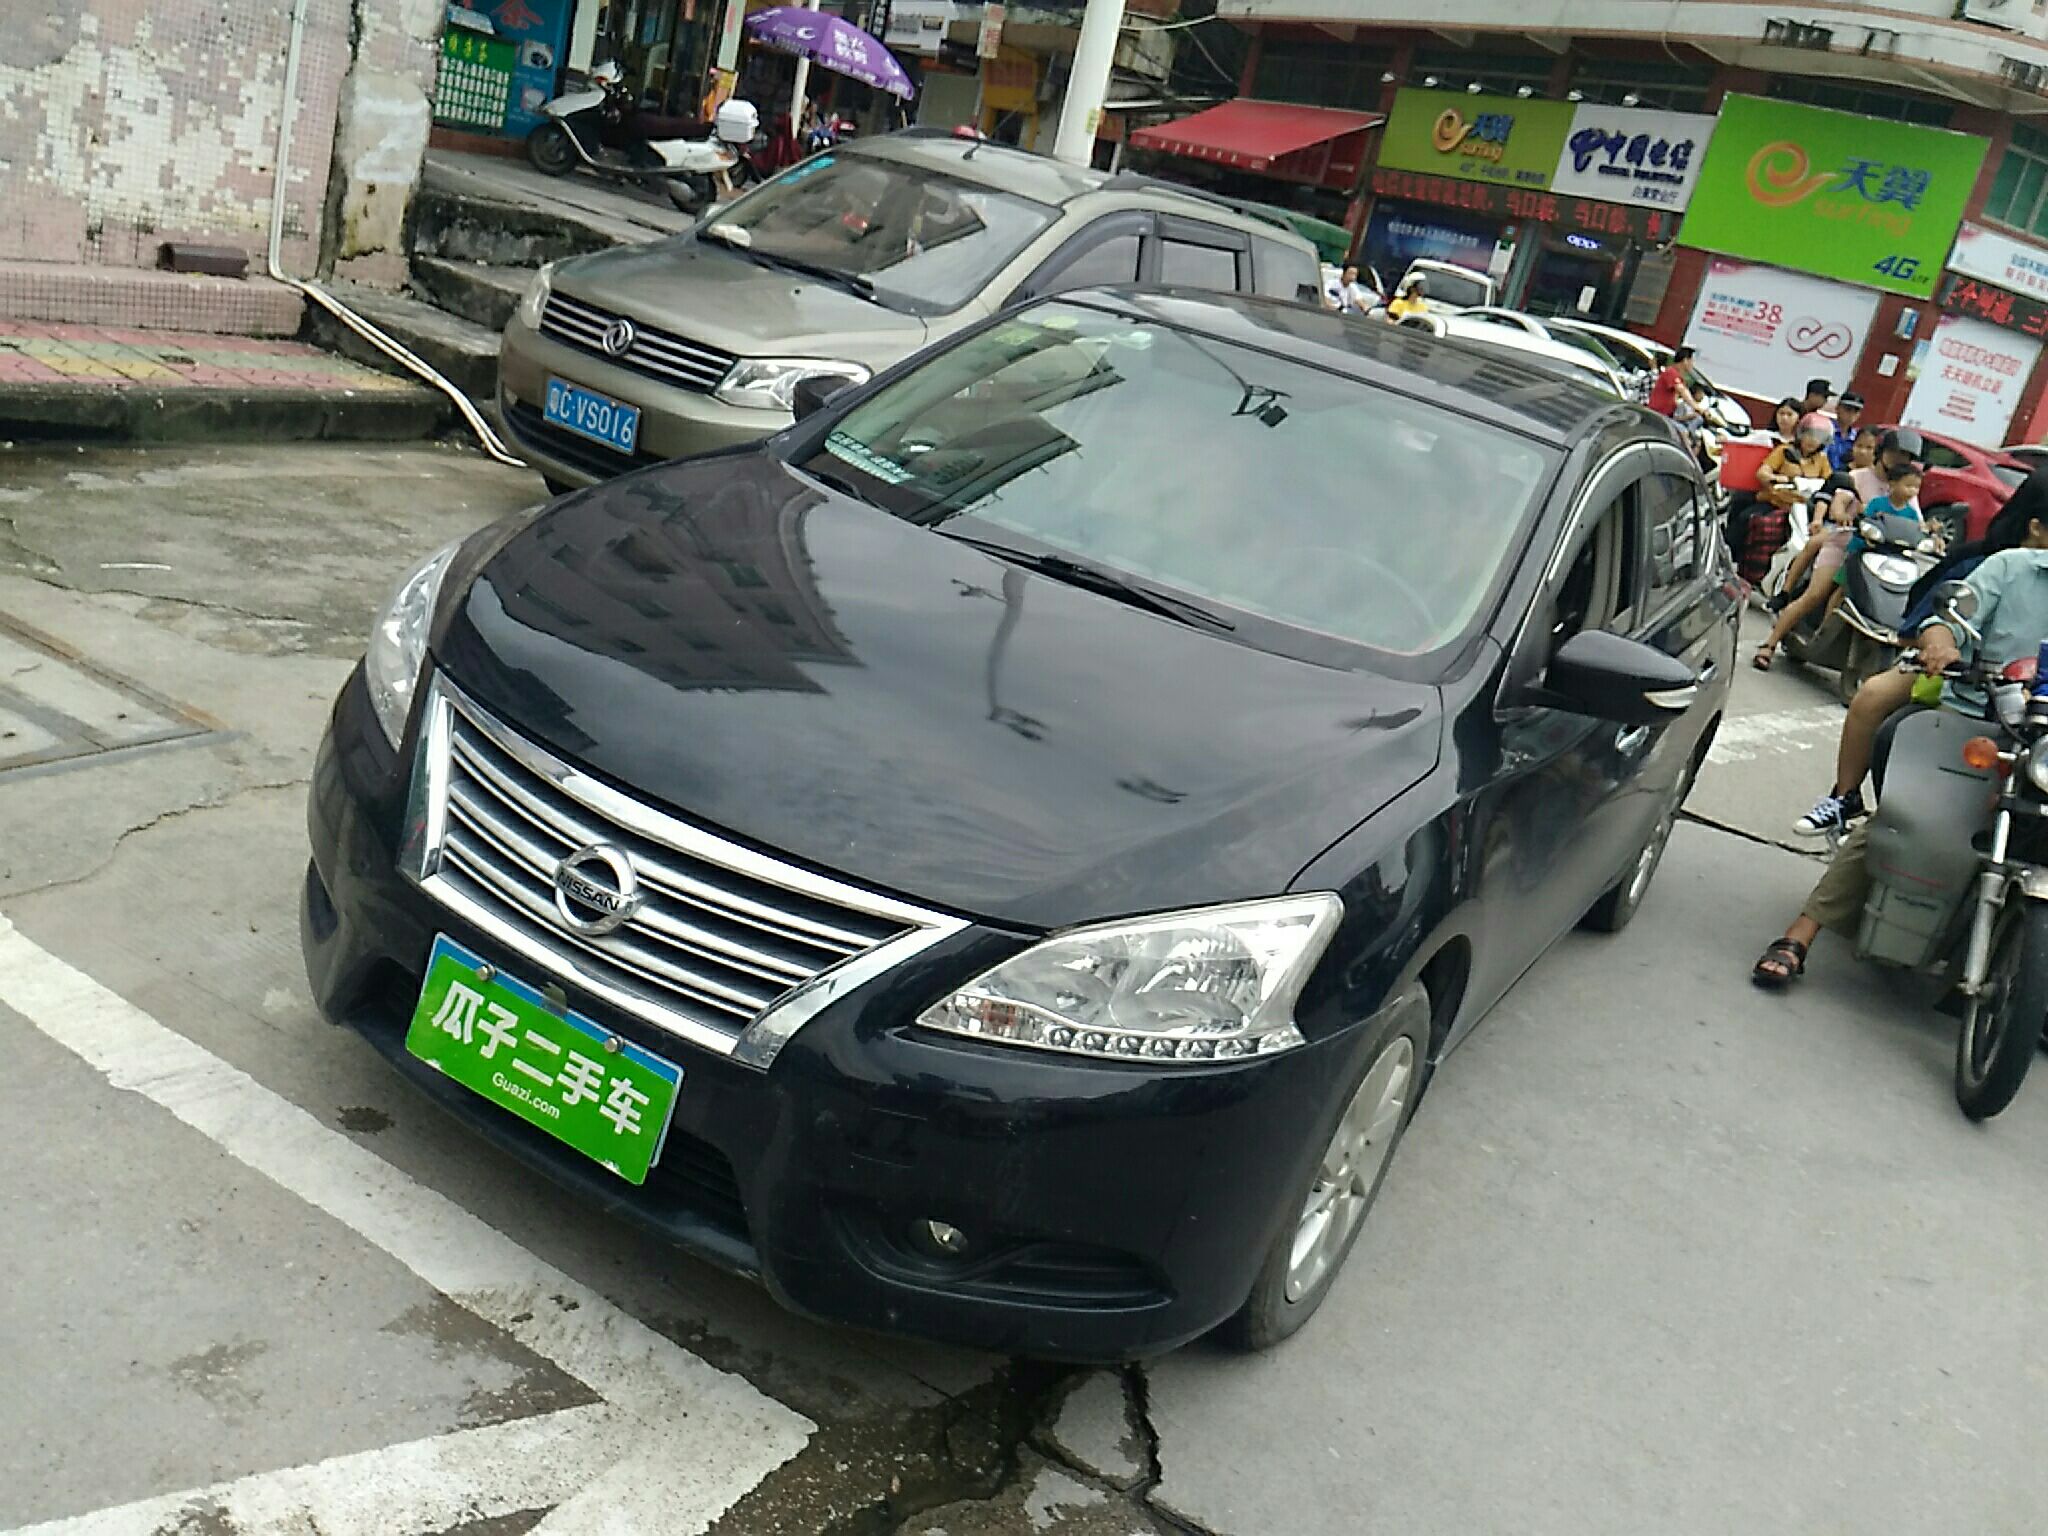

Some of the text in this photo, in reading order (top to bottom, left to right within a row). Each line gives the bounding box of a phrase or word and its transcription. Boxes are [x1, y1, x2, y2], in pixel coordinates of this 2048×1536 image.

[1468, 112, 1514, 145] 天翼
[1604, 129, 1695, 171] 中国电信
[1826, 155, 1932, 211] 天翼
[1813, 199, 1913, 237] surfing
[1873, 255, 1920, 280] 4G
[1754, 301, 1783, 325] 38
[557, 871, 619, 912] NISSAN
[431, 980, 651, 1136] 瓜子二手车
[491, 1071, 561, 1119] Guazi.com
